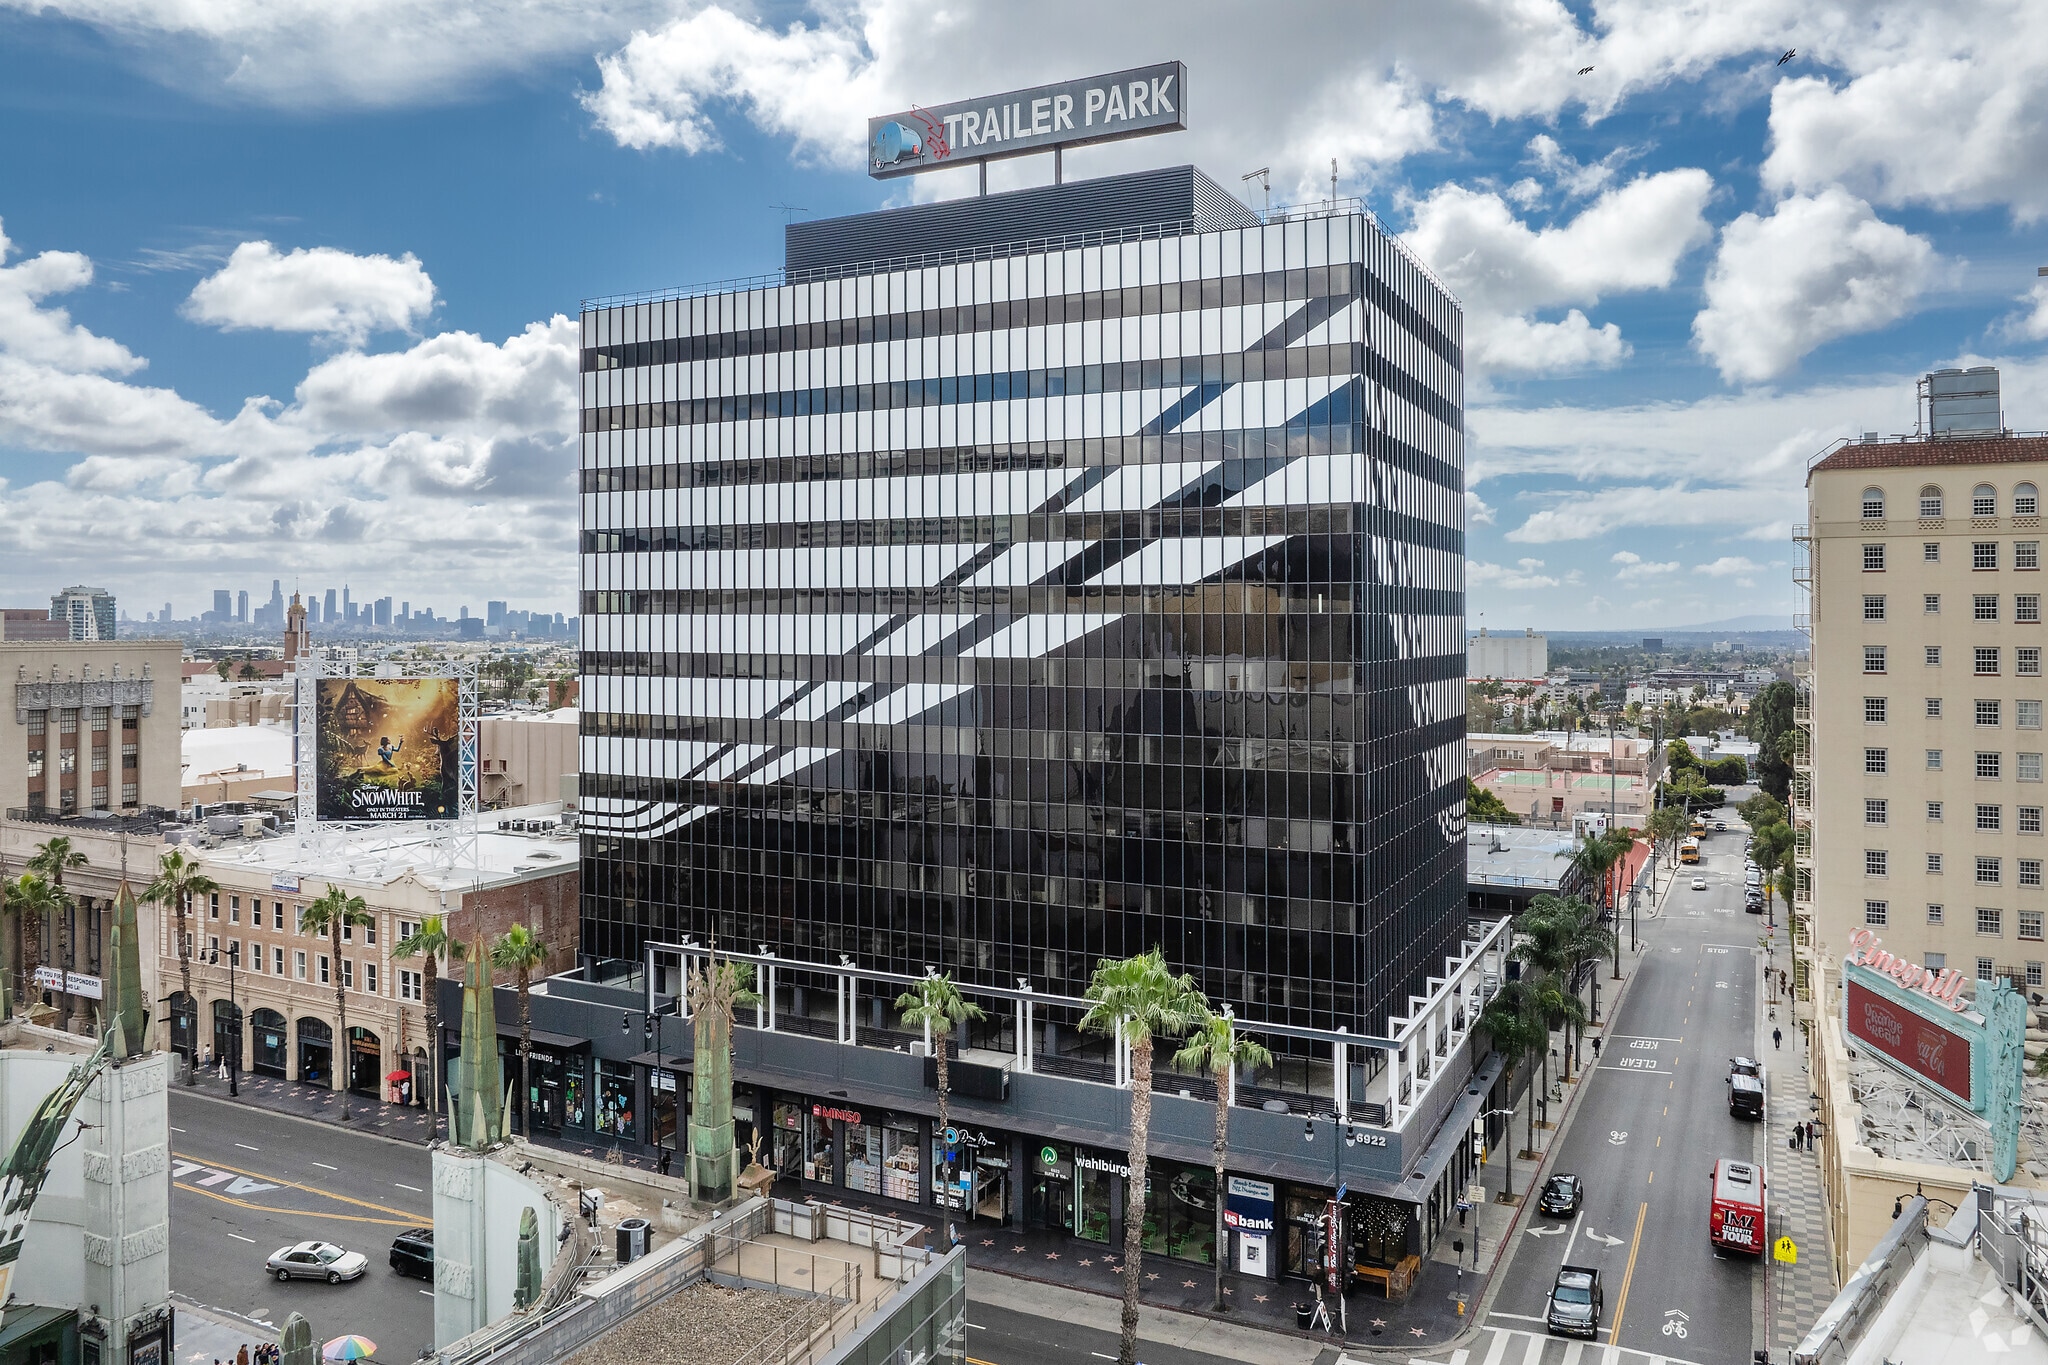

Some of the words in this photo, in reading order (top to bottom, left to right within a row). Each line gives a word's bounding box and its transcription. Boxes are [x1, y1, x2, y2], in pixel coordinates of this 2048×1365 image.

[943, 95, 1075, 150] TRAILER
[1085, 75, 1176, 127] PARK
[1849, 927, 1973, 1012] Cinegrill
[1629, 1040, 1659, 1050] KEEP
[529, 1051, 554, 1063] FRIENDS
[1620, 1057, 1657, 1069] CLEAR
[822, 1107, 861, 1124] MINISO
[1356, 1132, 1387, 1147] 6922
[1075, 1157, 1132, 1178] wahlburge
[936, 1197, 959, 1209] DOUTS
[1224, 1212, 1238, 1226] us
[1238, 1214, 1274, 1230] bank
[1719, 1207, 1757, 1229] TMZ
[1722, 1224, 1753, 1236] CELEBRITY
[1722, 1230, 1753, 1245] TOUR
